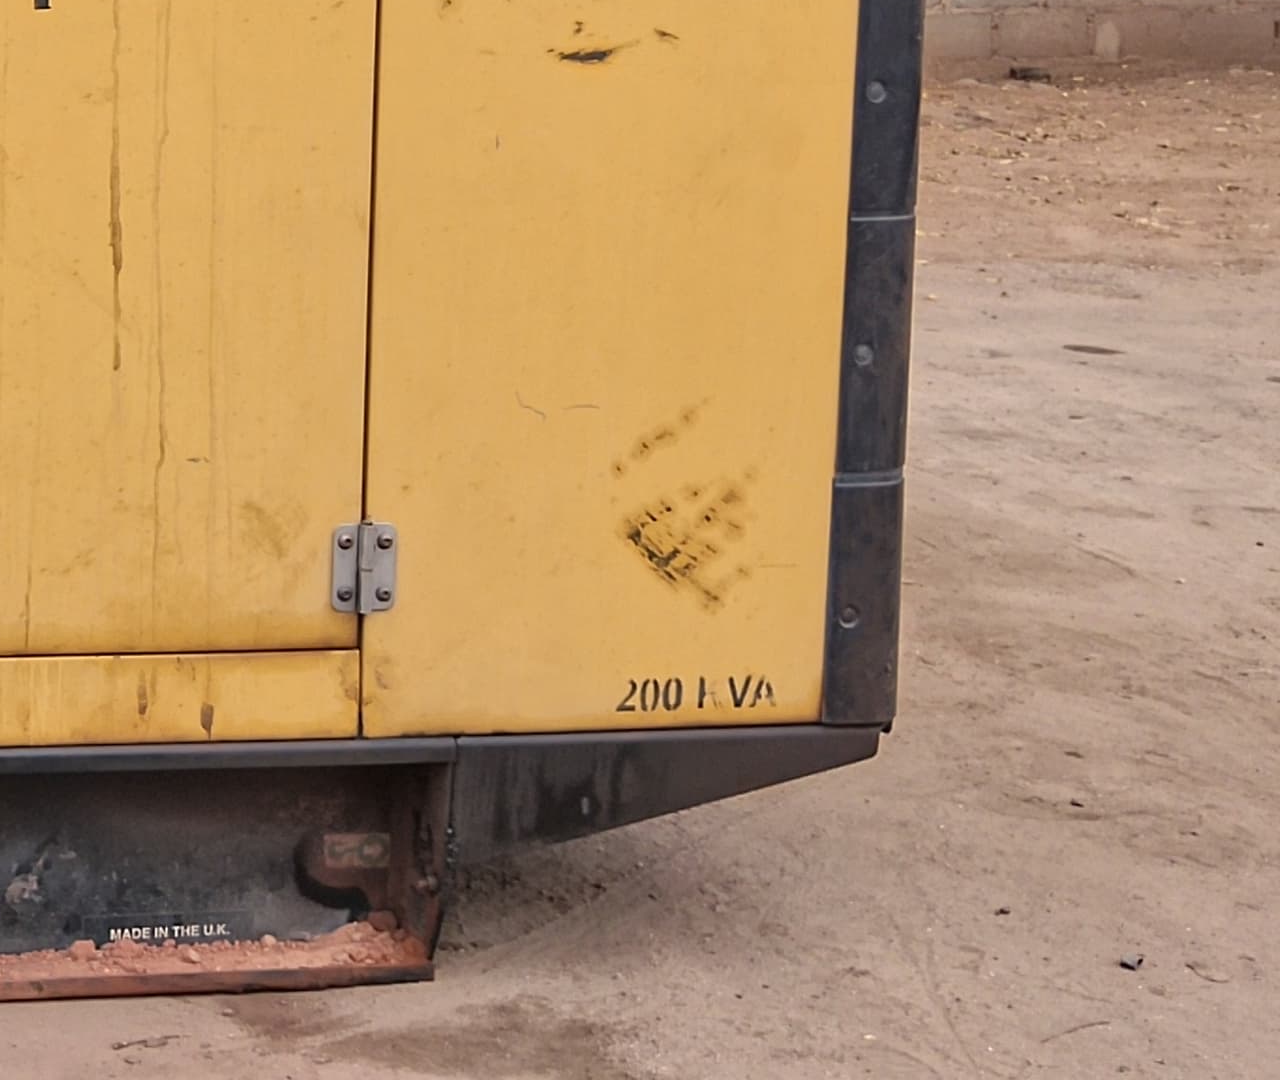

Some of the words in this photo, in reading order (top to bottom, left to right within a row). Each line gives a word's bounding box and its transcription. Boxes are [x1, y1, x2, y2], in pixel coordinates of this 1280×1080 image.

[615, 677, 683, 712] 200
[109, 927, 151, 940] MADE
[154, 926, 169, 939] IN
[172, 924, 200, 938] THE
[203, 923, 230, 936] U.K.
